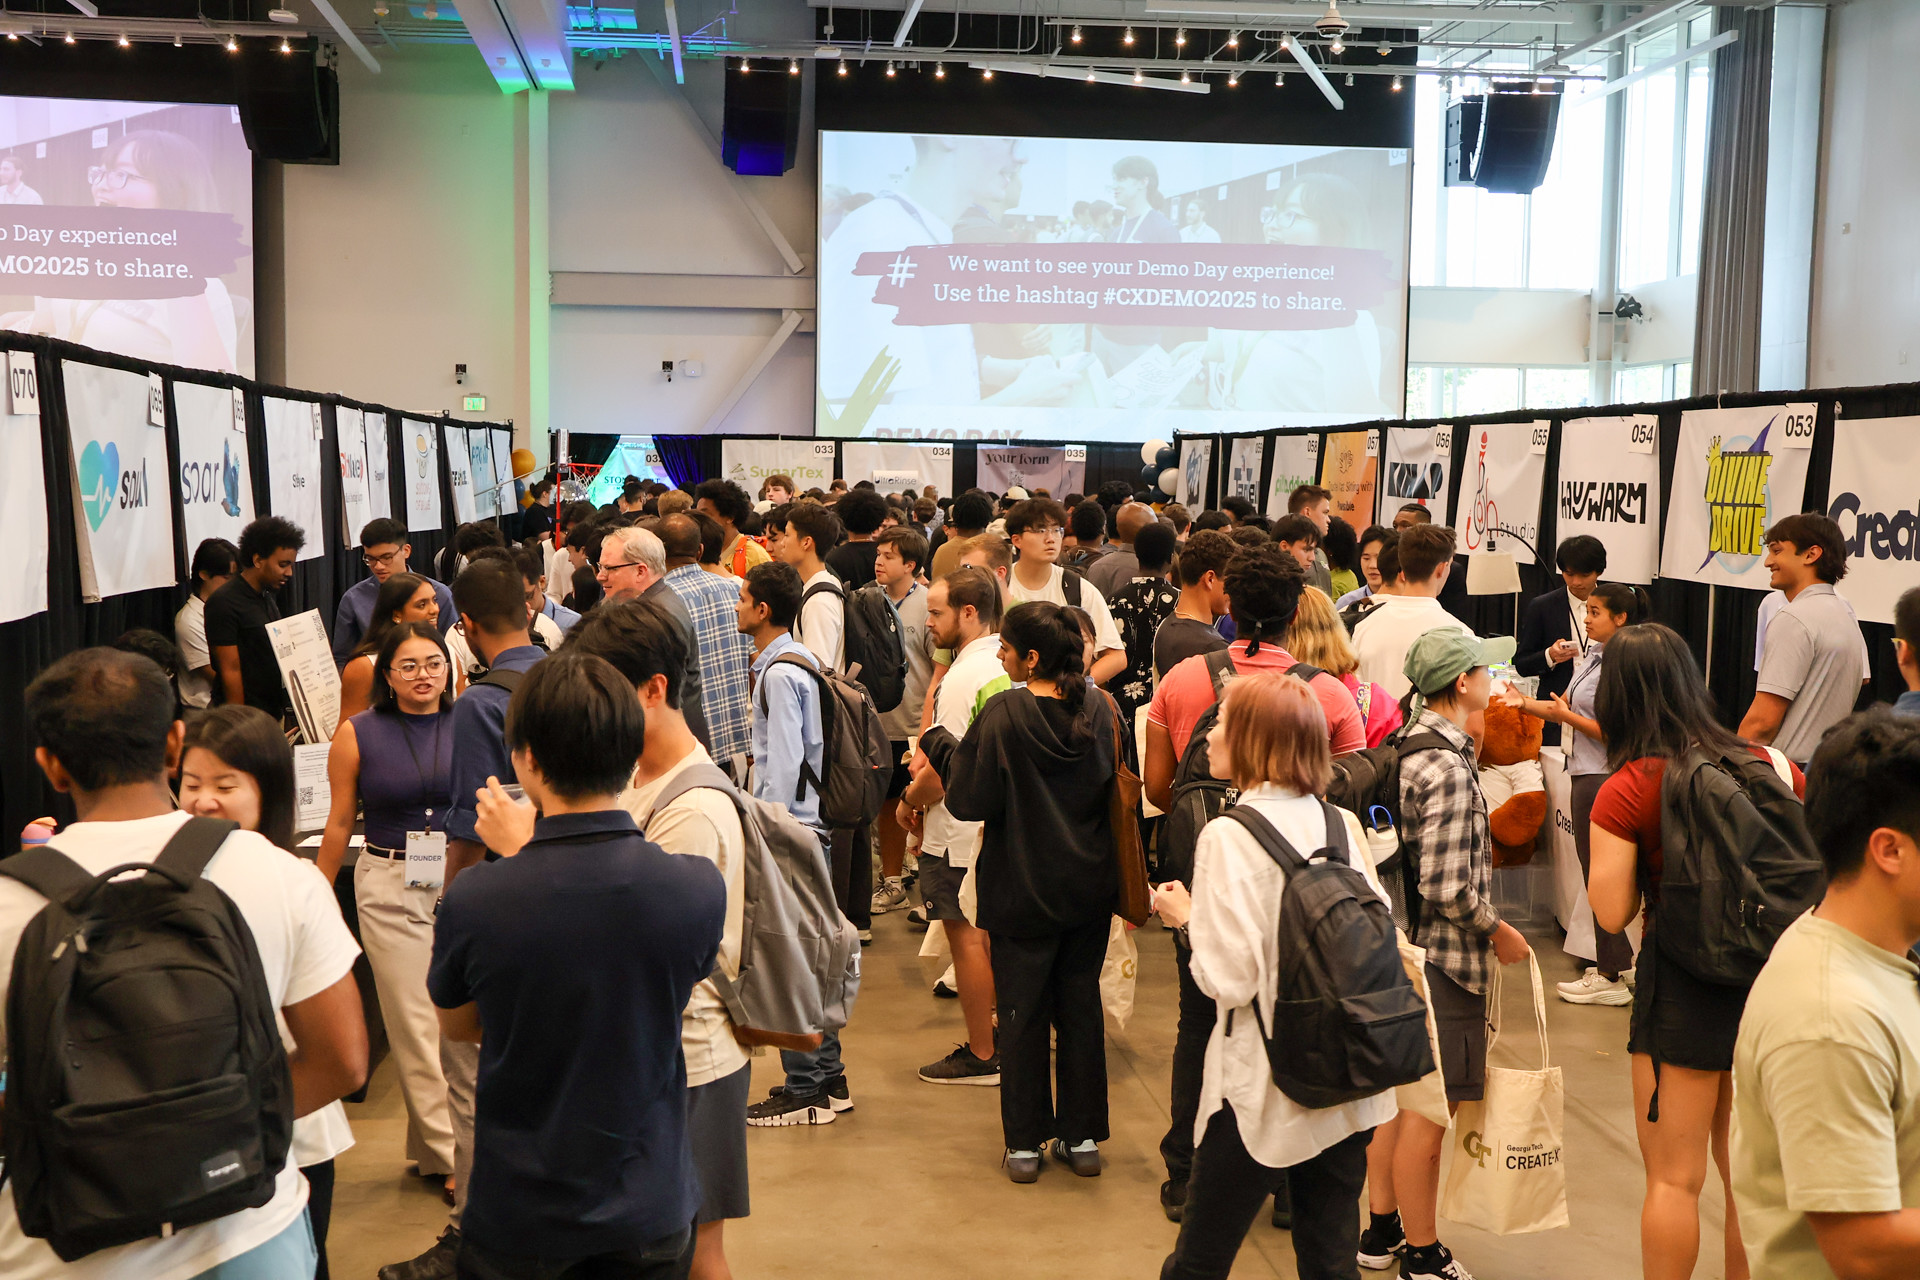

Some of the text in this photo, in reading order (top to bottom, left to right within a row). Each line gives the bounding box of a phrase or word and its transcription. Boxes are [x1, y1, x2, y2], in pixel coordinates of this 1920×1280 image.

[13, 224, 54, 247] Day
[59, 226, 177, 248] experience!
[95, 258, 117, 277] to
[124, 258, 194, 279] share.
[948, 255, 1335, 282] We want to see your Demo Day experience!
[933, 283, 1347, 312] Use the hashtag #CXDEMO2025 to share.
[13, 368, 36, 399] 070
[150, 386, 162, 414] 069
[1631, 424, 1654, 445] 054
[1785, 415, 1814, 438] 053
[1367, 436, 1379, 450] 057
[1435, 432, 1450, 449] 056
[1532, 428, 1548, 446] 055
[814, 445, 834, 455] 033
[932, 447, 951, 456] 034
[1066, 448, 1085, 458] 035
[1307, 440, 1318, 453] 058
[645, 454, 662, 464] 03
[985, 452, 1050, 466] your form
[749, 464, 824, 479] SugarTex
[1705, 451, 1774, 504] DIVINE
[874, 476, 918, 486] UltraRinse
[1709, 504, 1767, 557] DRIVE
[409, 854, 442, 862] FOUNDER
[1506, 1143, 1544, 1154] Georgia Tech
